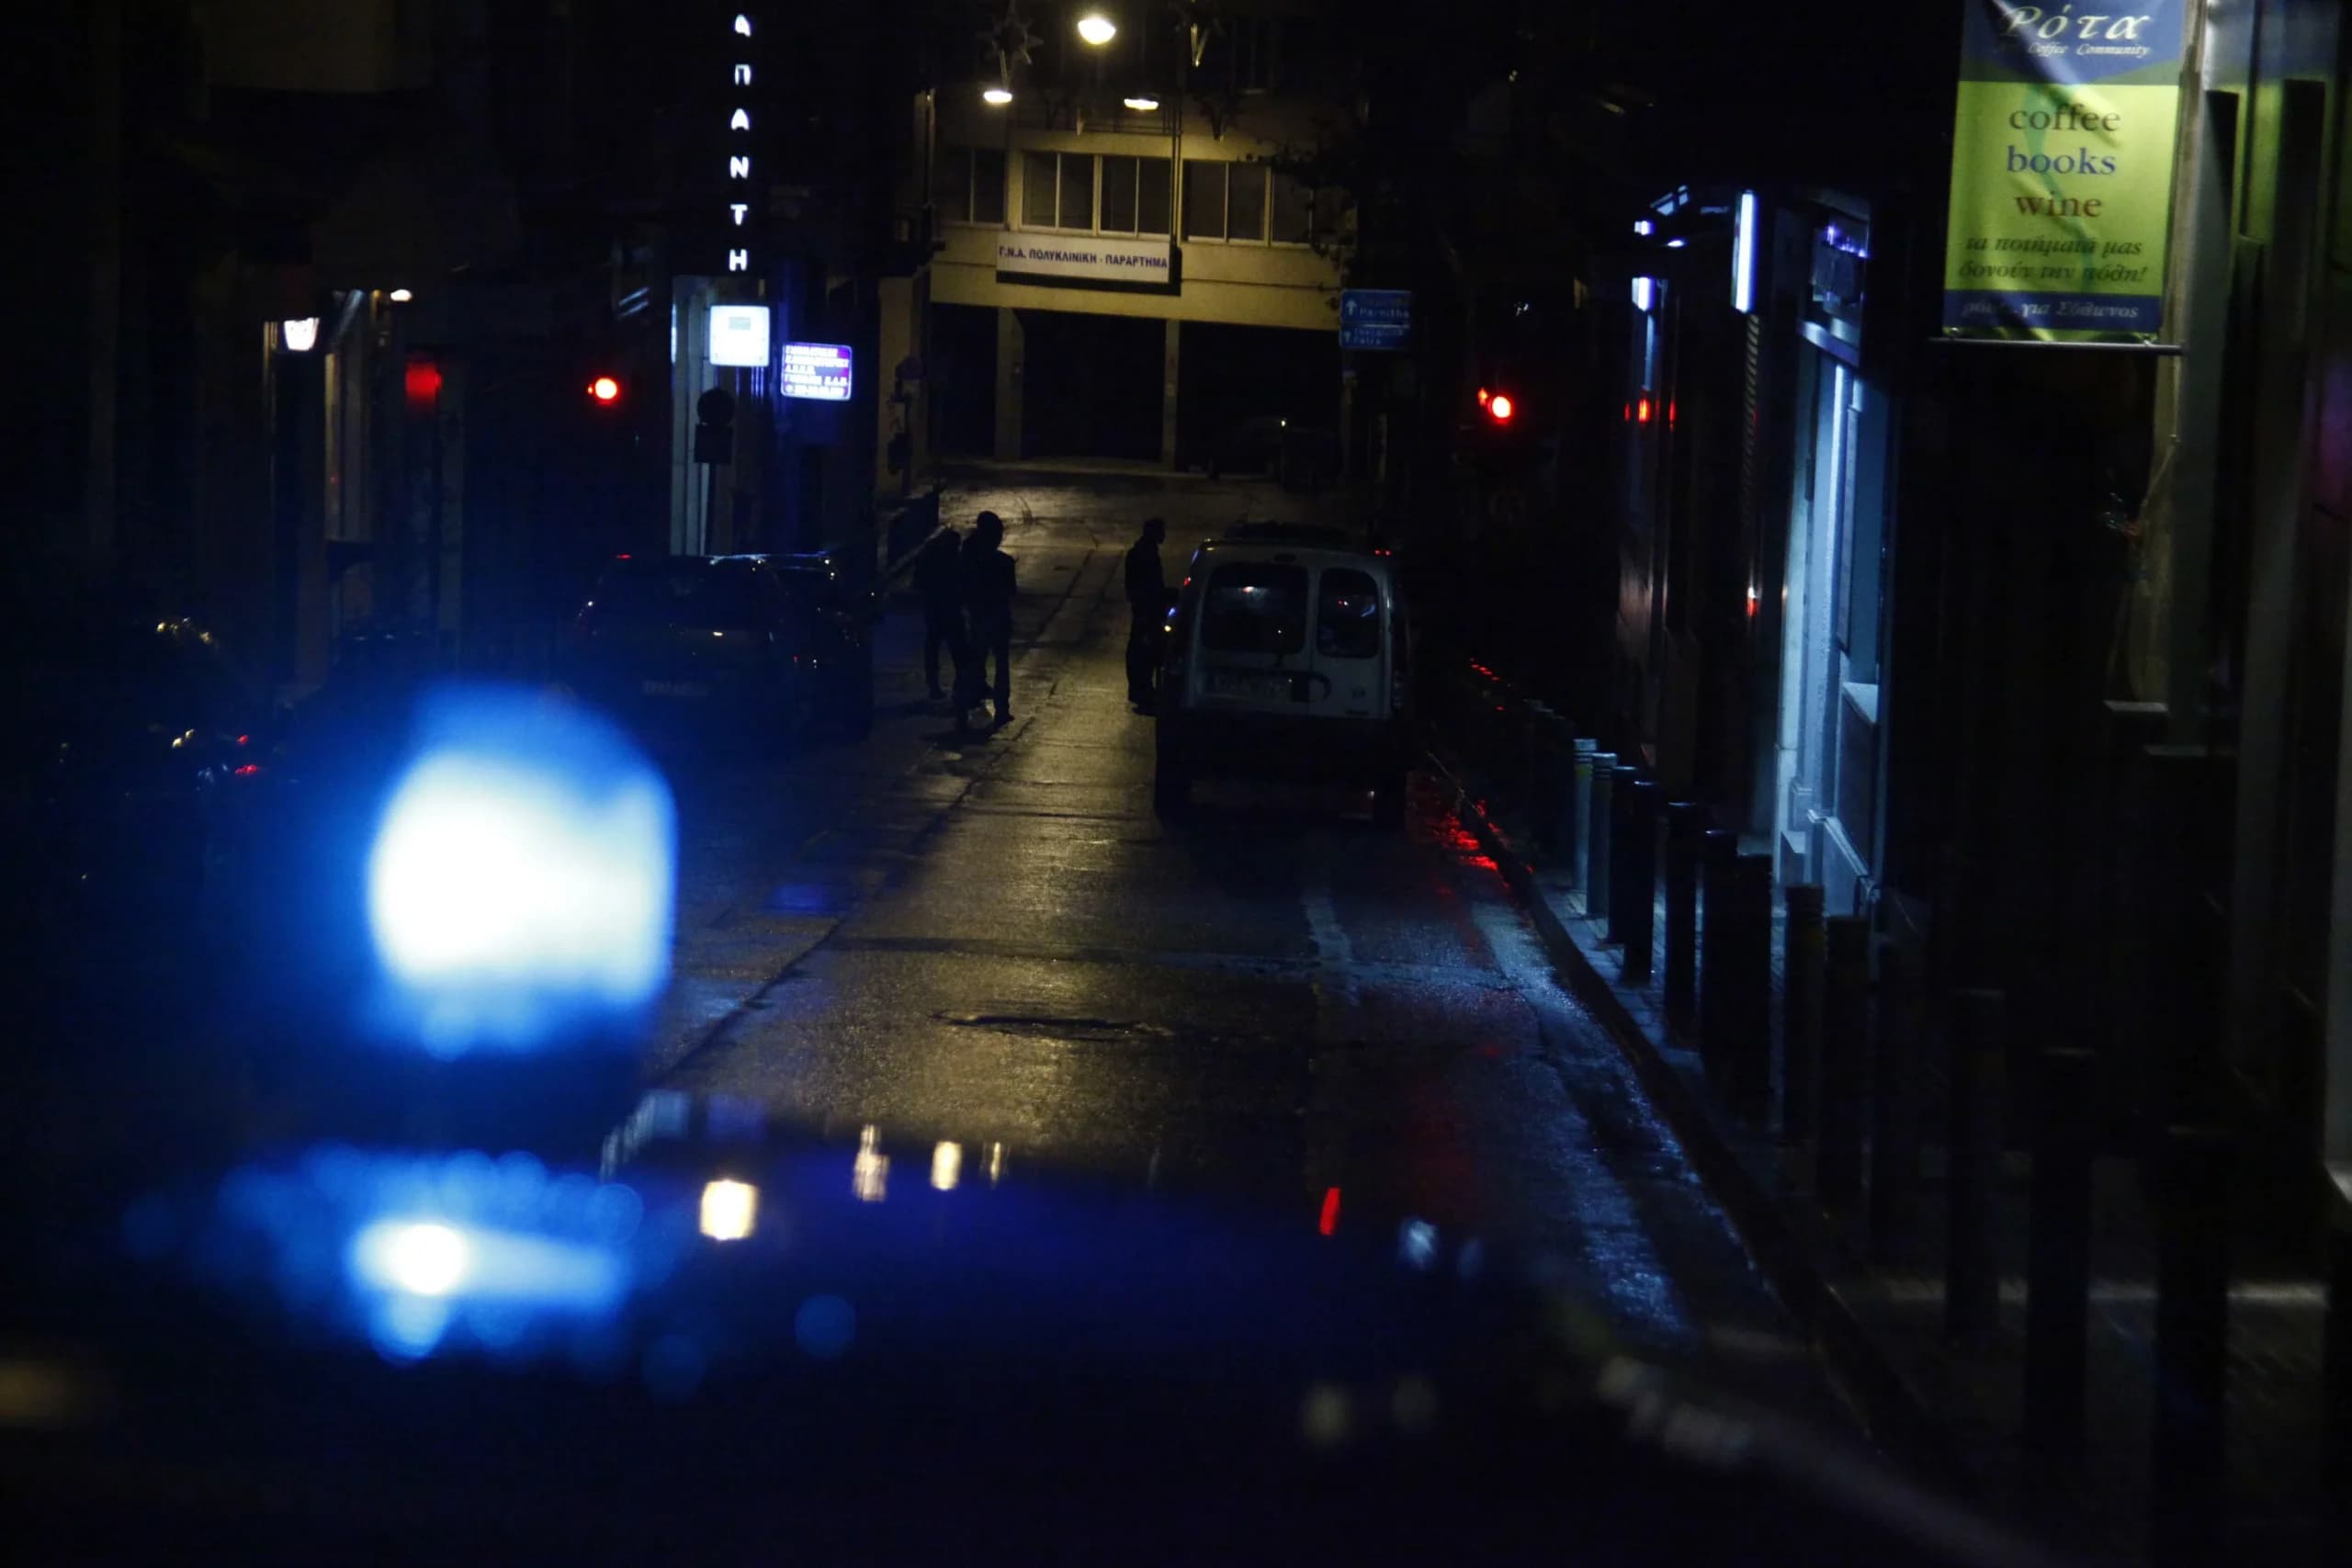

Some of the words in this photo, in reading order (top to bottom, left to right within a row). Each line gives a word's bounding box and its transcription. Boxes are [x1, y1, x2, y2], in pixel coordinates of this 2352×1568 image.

[2027, 41, 2068, 58] Coffee
[2075, 42, 2151, 59] Community
[2008, 102, 2121, 132] coffee
[2006, 143, 2117, 176] books
[2014, 190, 2103, 219] wine
[999, 245, 1027, 259] Γ.Ν.Α.
[1029, 247, 1098, 265] ΠΟΛΥΚΛΙΝΙΚΗ
[1105, 254, 1168, 269] ΠΑΡΑΡΤΗΜΑ
